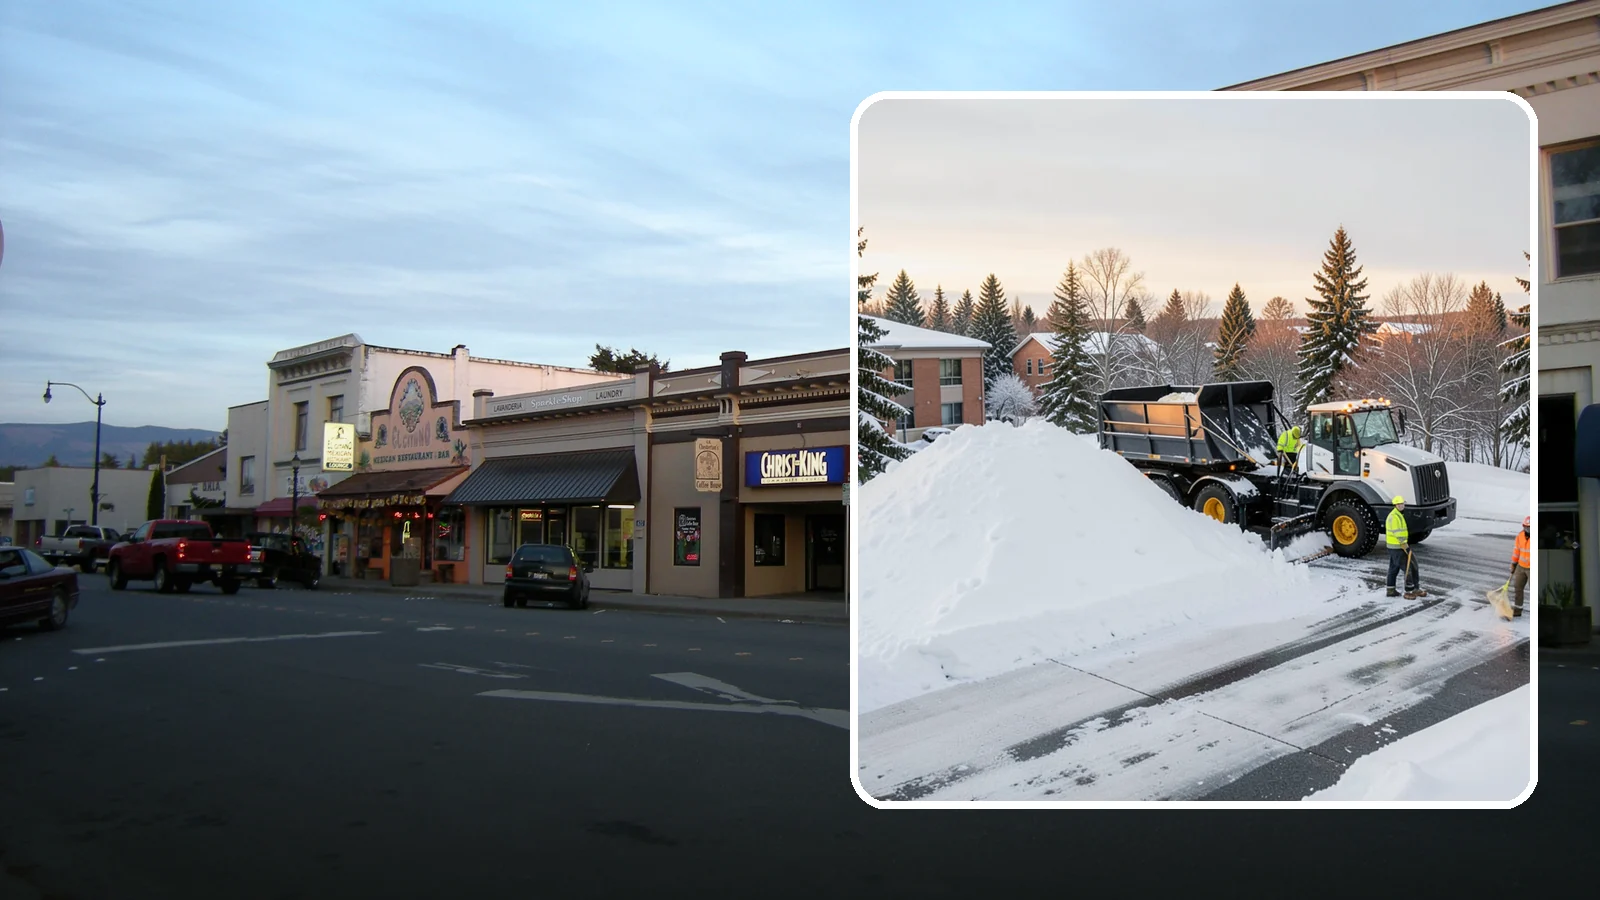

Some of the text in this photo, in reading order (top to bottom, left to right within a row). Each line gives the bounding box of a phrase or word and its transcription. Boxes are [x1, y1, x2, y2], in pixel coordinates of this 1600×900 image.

[530, 394, 583, 409] Sparkle Shop
[595, 389, 624, 400] LAUNDRY
[493, 402, 523, 412] LAVANDERIA
[374, 454, 398, 465] MEXICAN
[397, 451, 434, 462] RESTAURANT
[438, 450, 450, 459] BAR
[761, 450, 828, 478] CHRIST KING
